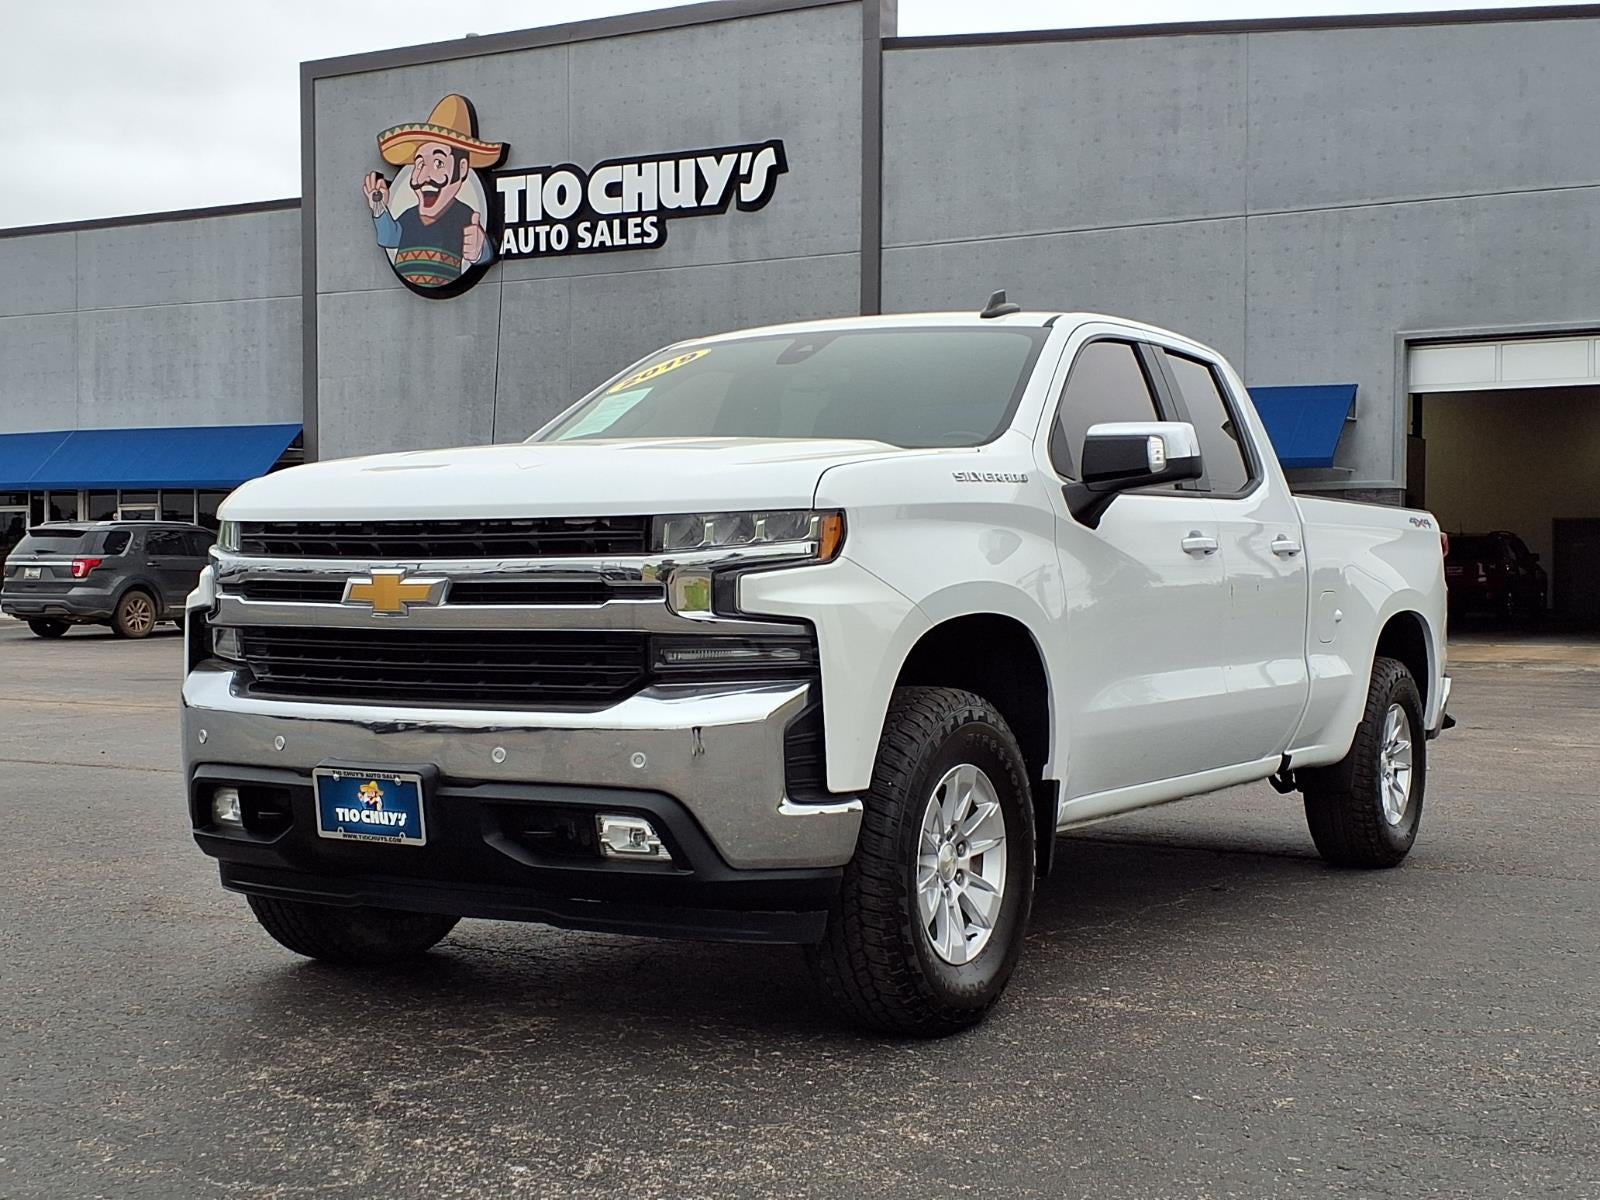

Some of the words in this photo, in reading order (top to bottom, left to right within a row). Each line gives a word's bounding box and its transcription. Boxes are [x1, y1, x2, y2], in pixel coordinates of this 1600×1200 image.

[497, 170, 582, 223] TIO
[588, 148, 776, 215] CHUY'S
[499, 225, 569, 255] AUTO
[578, 216, 658, 248] SALES
[952, 472, 1028, 483] SILVERADO
[336, 808, 360, 822] TIO
[361, 810, 407, 827] CHUY'S
